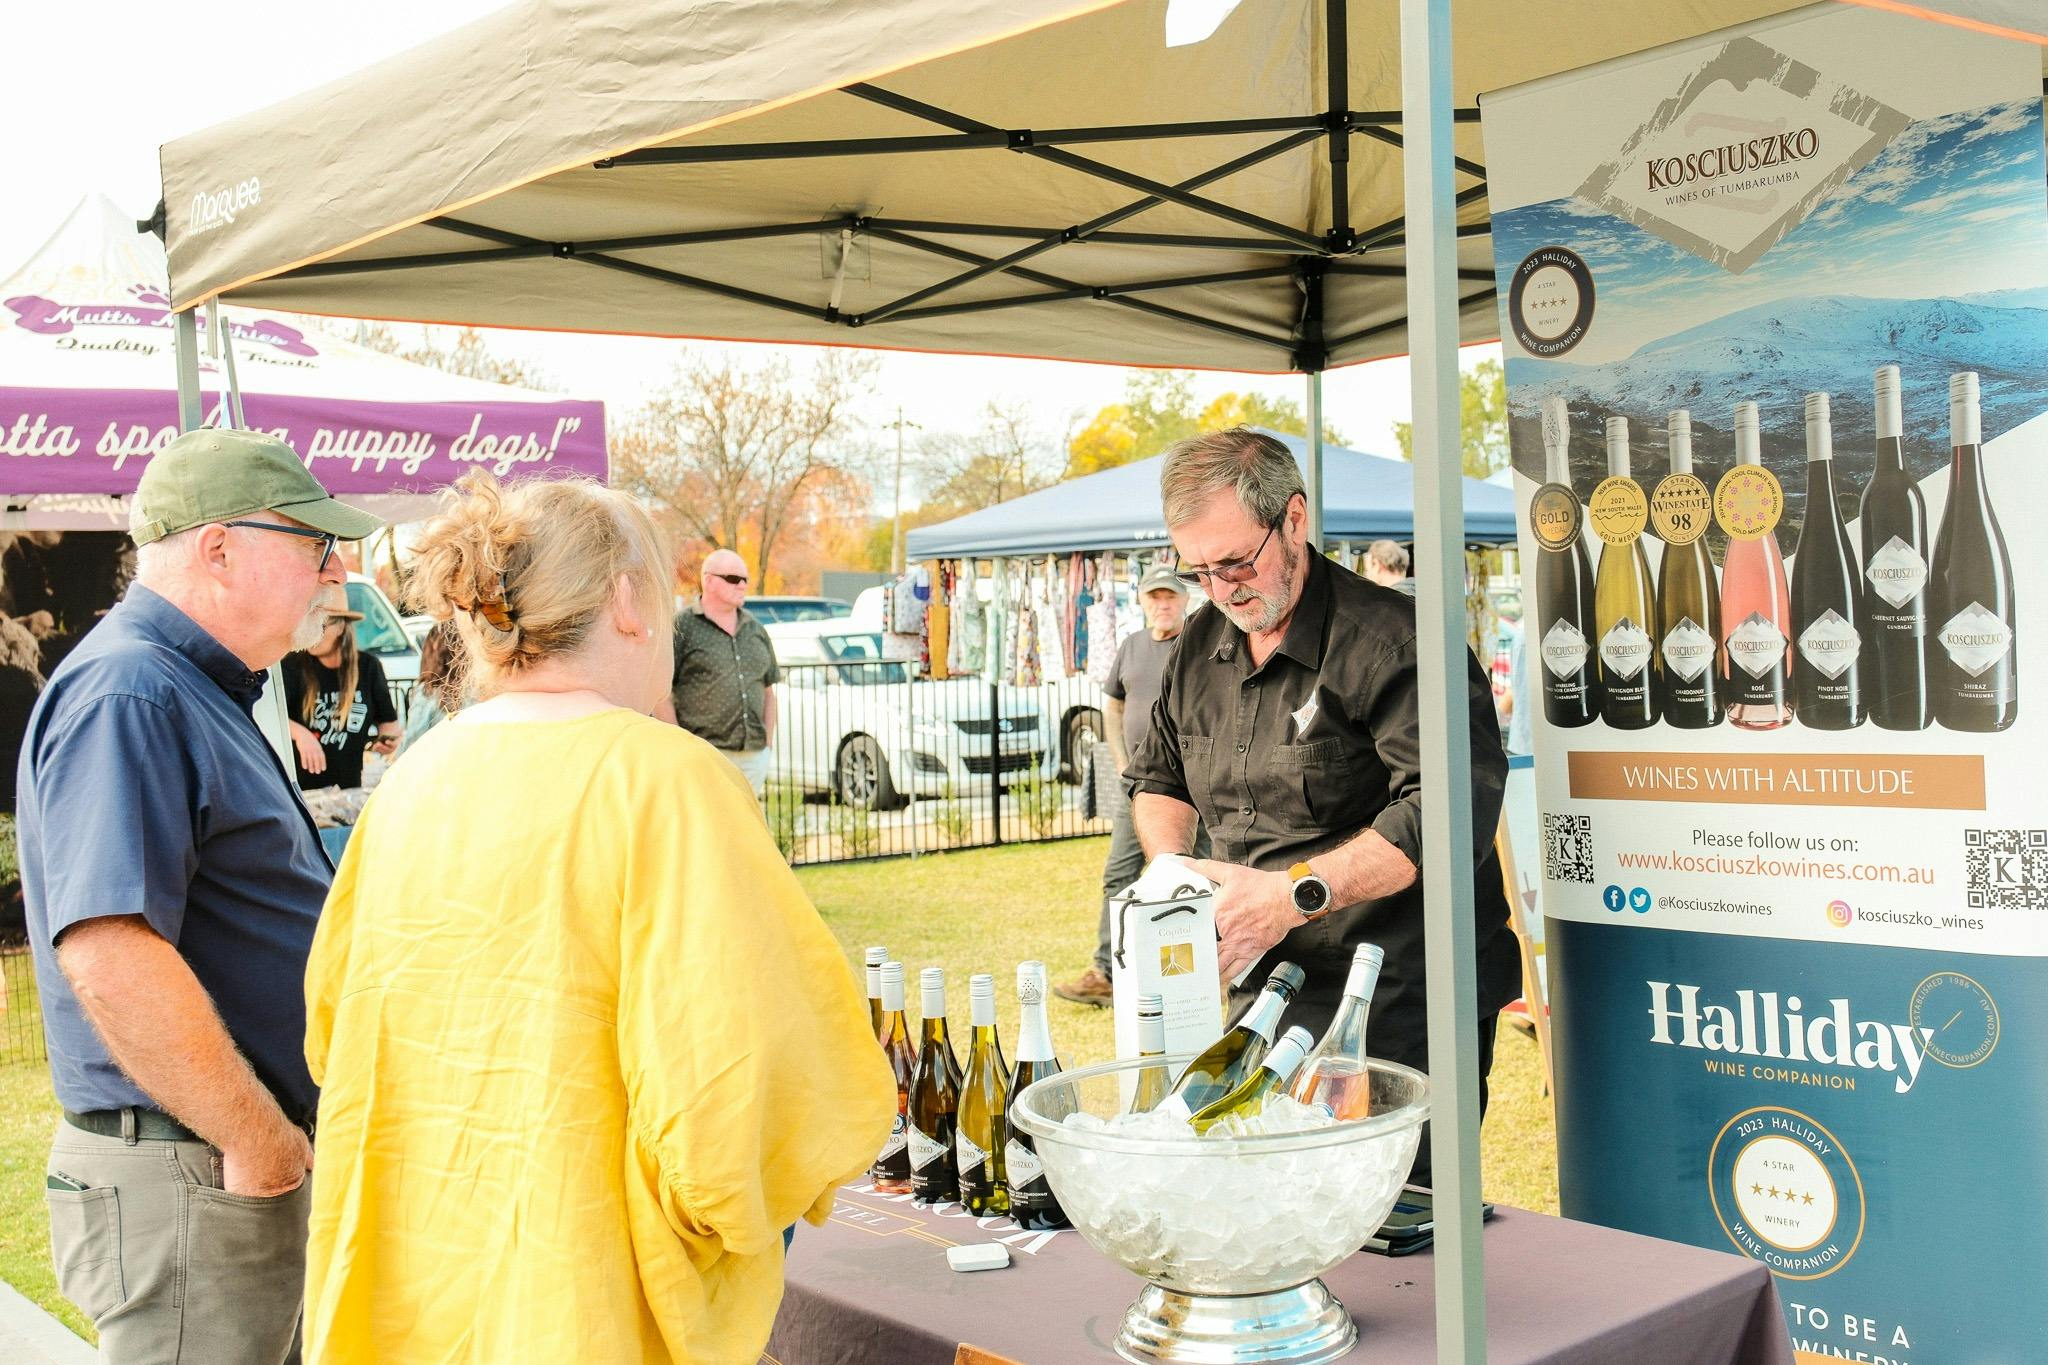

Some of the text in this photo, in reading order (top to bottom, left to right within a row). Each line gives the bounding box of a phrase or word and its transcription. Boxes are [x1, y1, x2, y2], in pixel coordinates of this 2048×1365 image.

[1646, 128, 1820, 192] KOSCIUSZKO
[1665, 170, 1800, 206] WINES OF TUMBARUMBA
[1523, 253, 1577, 274] 2023 HALLIDAY
[44, 306, 140, 325] Mutts
[56, 336, 159, 356] Quality
[1521, 325, 1582, 353] WINE COMPANION
[0, 413, 81, 456] tta
[303, 427, 437, 476] puppy
[1608, 480, 1618, 488] WINE
[1620, 480, 1638, 492] AWARDS
[1670, 478, 1695, 486] STARS
[1718, 479, 1731, 506] NATIONAL
[1731, 470, 1746, 480] COOL
[1746, 469, 1768, 481] CLIMATE
[1540, 510, 1570, 525] GOLD
[1671, 513, 1692, 532] 98
[1600, 530, 1639, 543] GOLD MEDAL
[1670, 532, 1695, 540] POINTS
[1732, 524, 1766, 534] GOLD MEDAL
[1872, 614, 1895, 622] CABERNET
[1807, 638, 1855, 651] KOSCIUSZKO
[1947, 632, 2003, 646] KOSCIUSZKO
[1623, 765, 1915, 795] WINES WITH ALTITUDE
[1692, 829, 1859, 852] Please follow us on:
[1618, 850, 1935, 885] www.kosciuszkowines.com.au
[1658, 896, 1772, 916] @Kosciuszkowines
[1858, 907, 1984, 930] kosciuszko_wines
[1912, 977, 1944, 1026] ESTABLISHED
[1646, 980, 1935, 1094] Halliday
[1705, 1059, 1856, 1092] WINE COMPANION
[1737, 1117, 1832, 1156] 2023 HALLIDAY
[1762, 1160, 1795, 1172] 4 STAR
[1764, 1214, 1800, 1228] WINERY
[1733, 1222, 1840, 1270] WINE COMPANION
[1790, 1302, 1910, 1349] TO BE A
